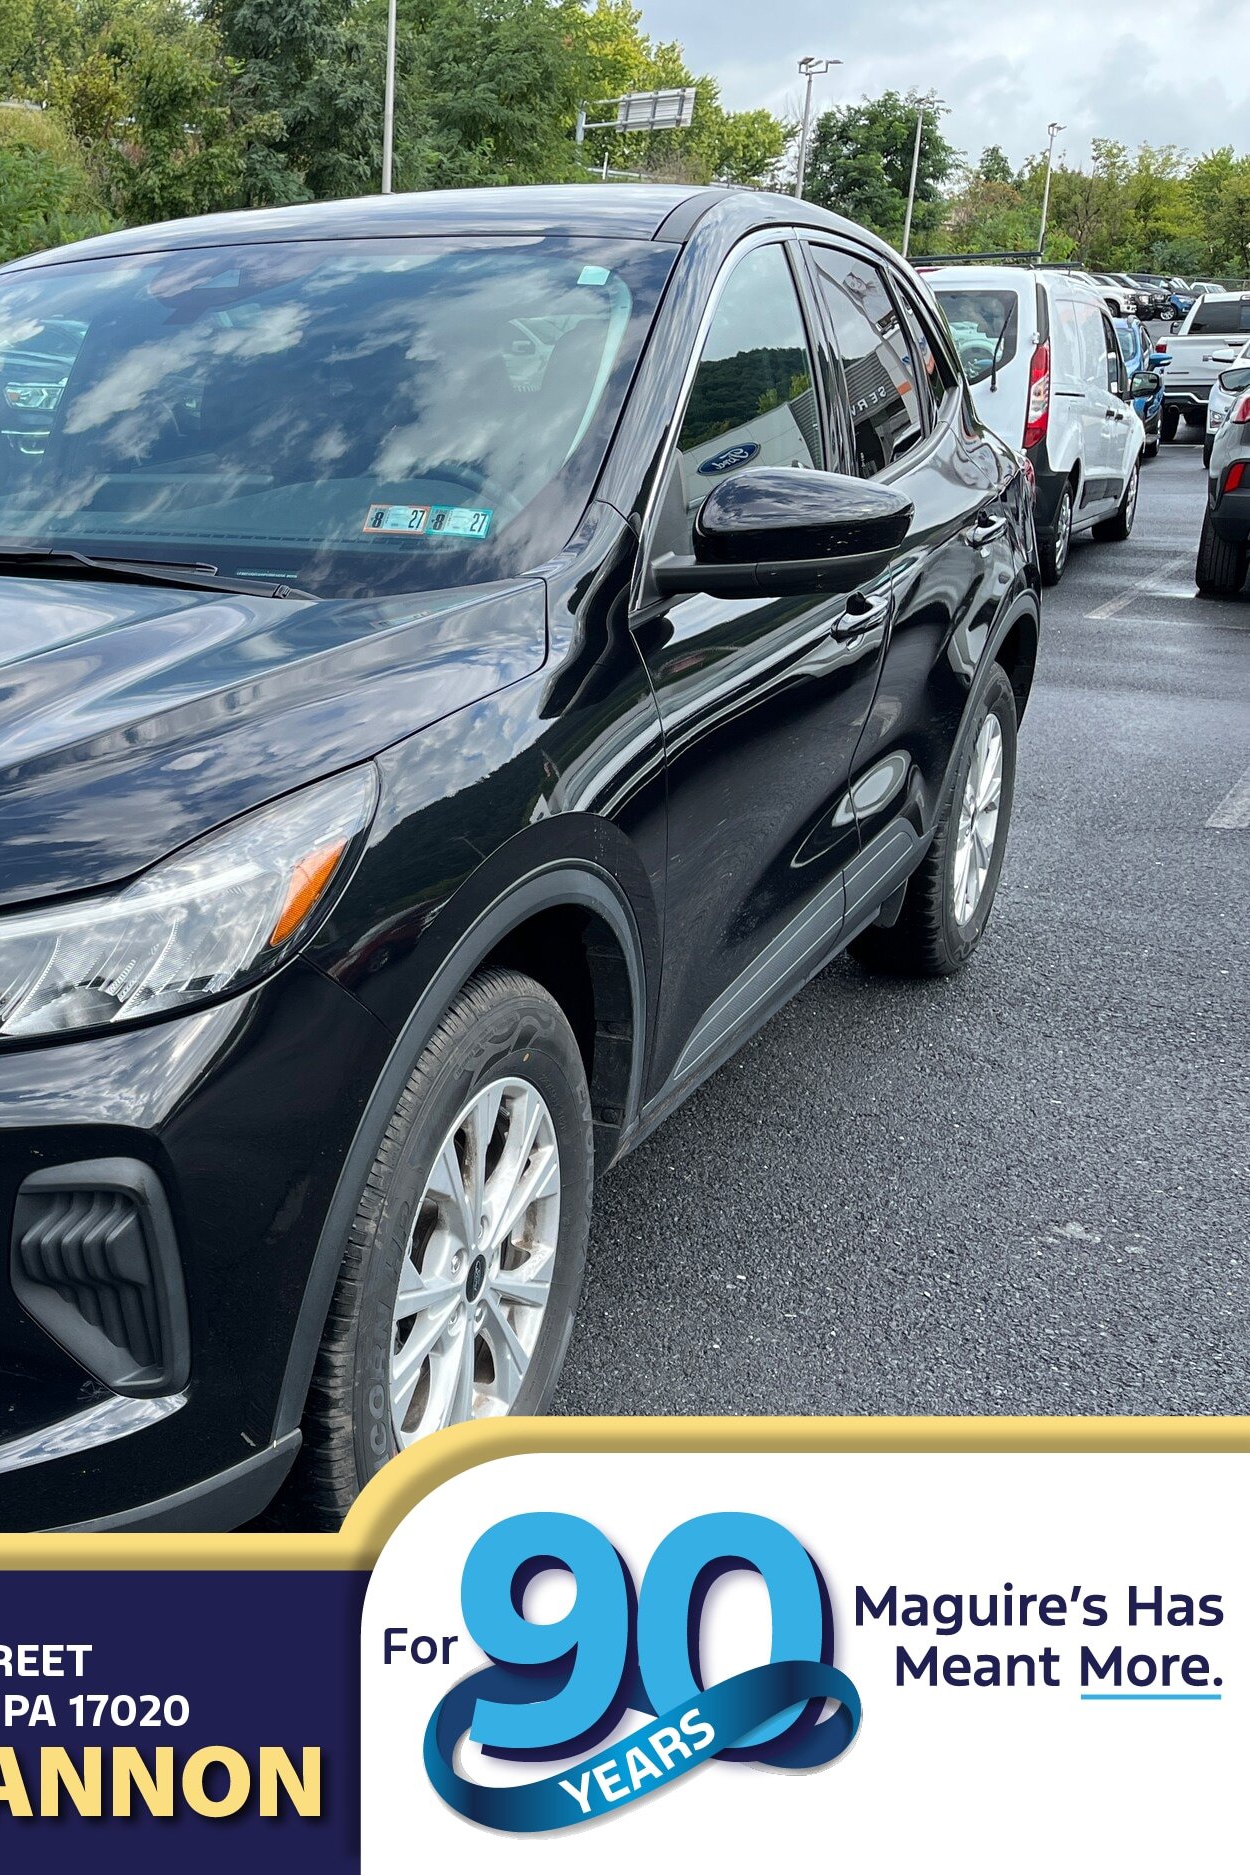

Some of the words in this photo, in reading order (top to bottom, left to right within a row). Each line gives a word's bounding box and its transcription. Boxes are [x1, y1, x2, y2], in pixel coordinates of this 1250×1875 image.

[372, 511, 384, 528] 8
[408, 509, 425, 530] 27
[432, 513, 445, 531] 8
[469, 512, 487, 533] 27
